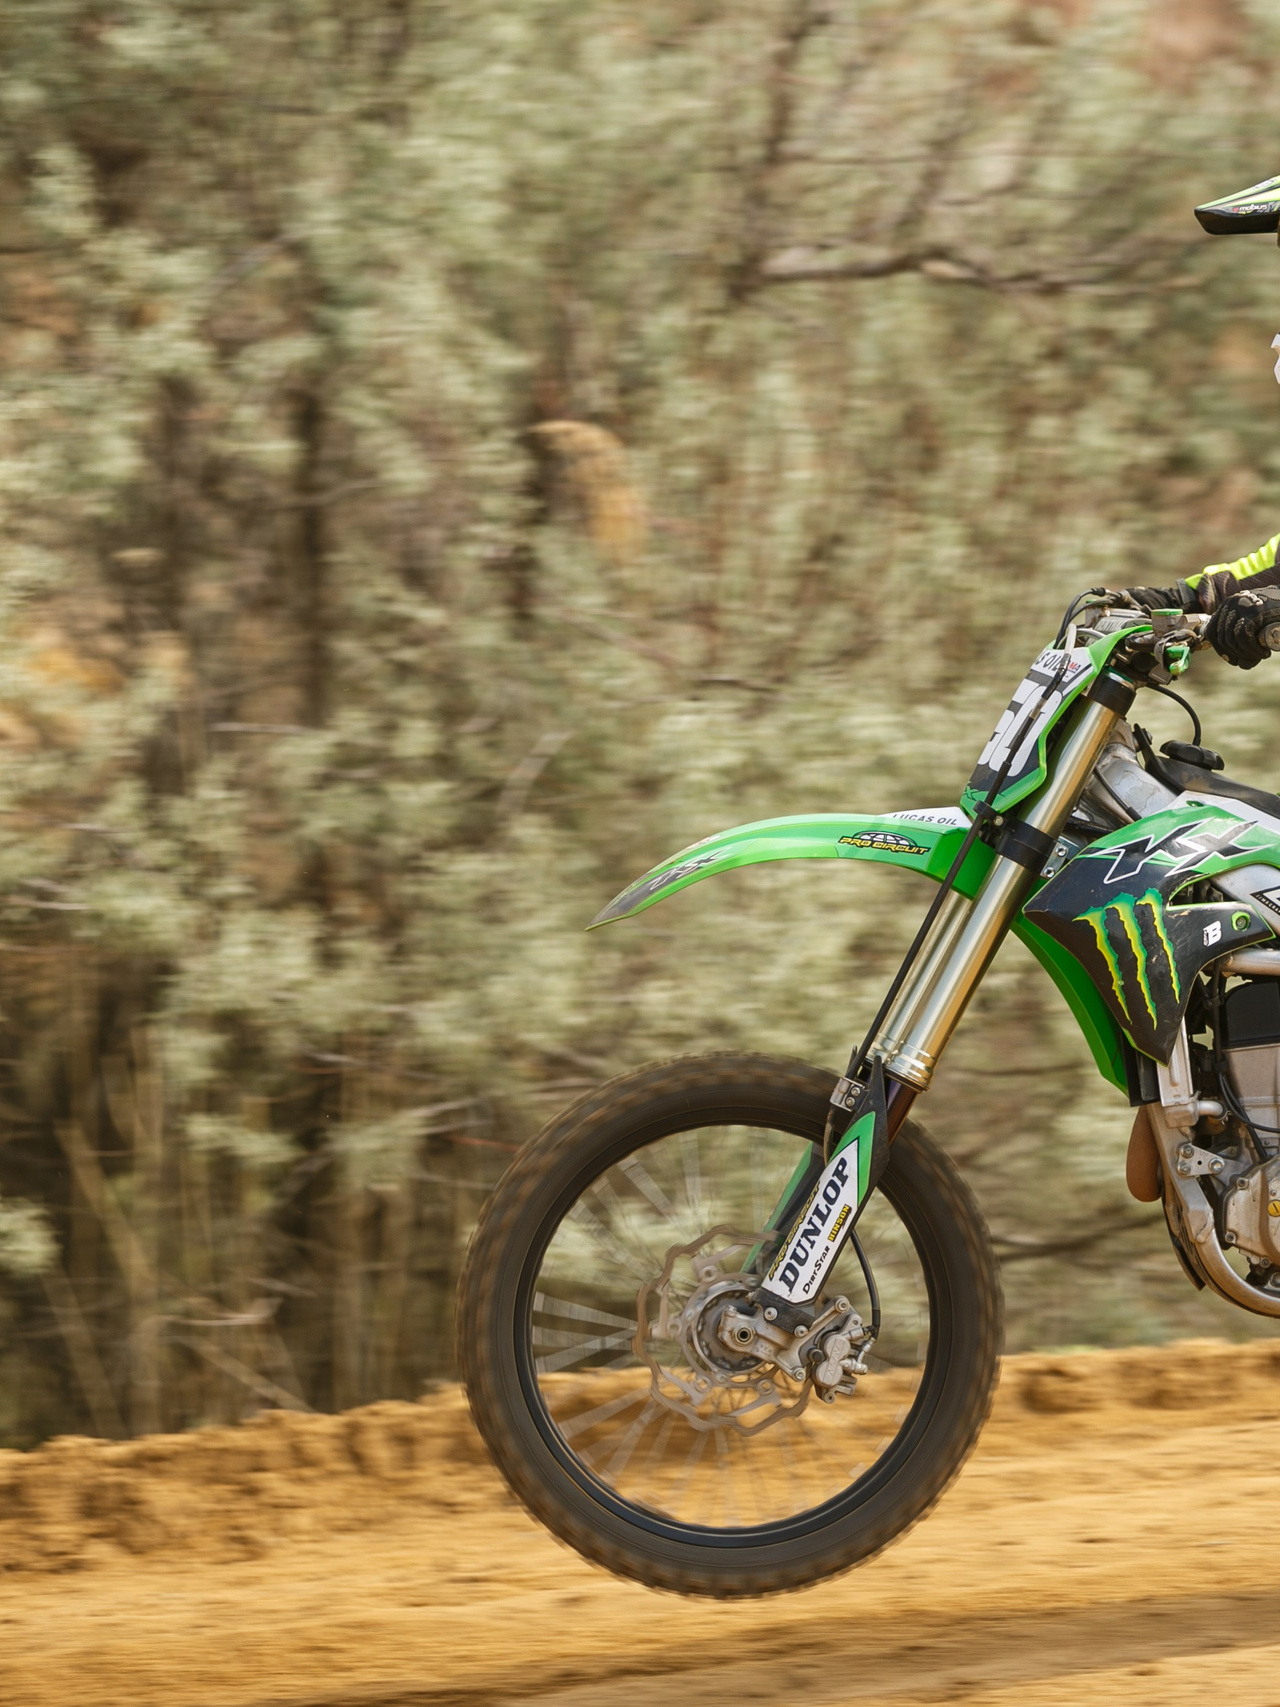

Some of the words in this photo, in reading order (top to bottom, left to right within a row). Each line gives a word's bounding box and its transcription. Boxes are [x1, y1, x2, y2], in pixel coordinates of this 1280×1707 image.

[937, 817, 958, 826] OIL
[839, 837, 871, 847] PRO
[872, 842, 929, 854] CIRCUIT
[779, 1157, 848, 1293] DUNLOP
[828, 1204, 850, 1242] HINSON
